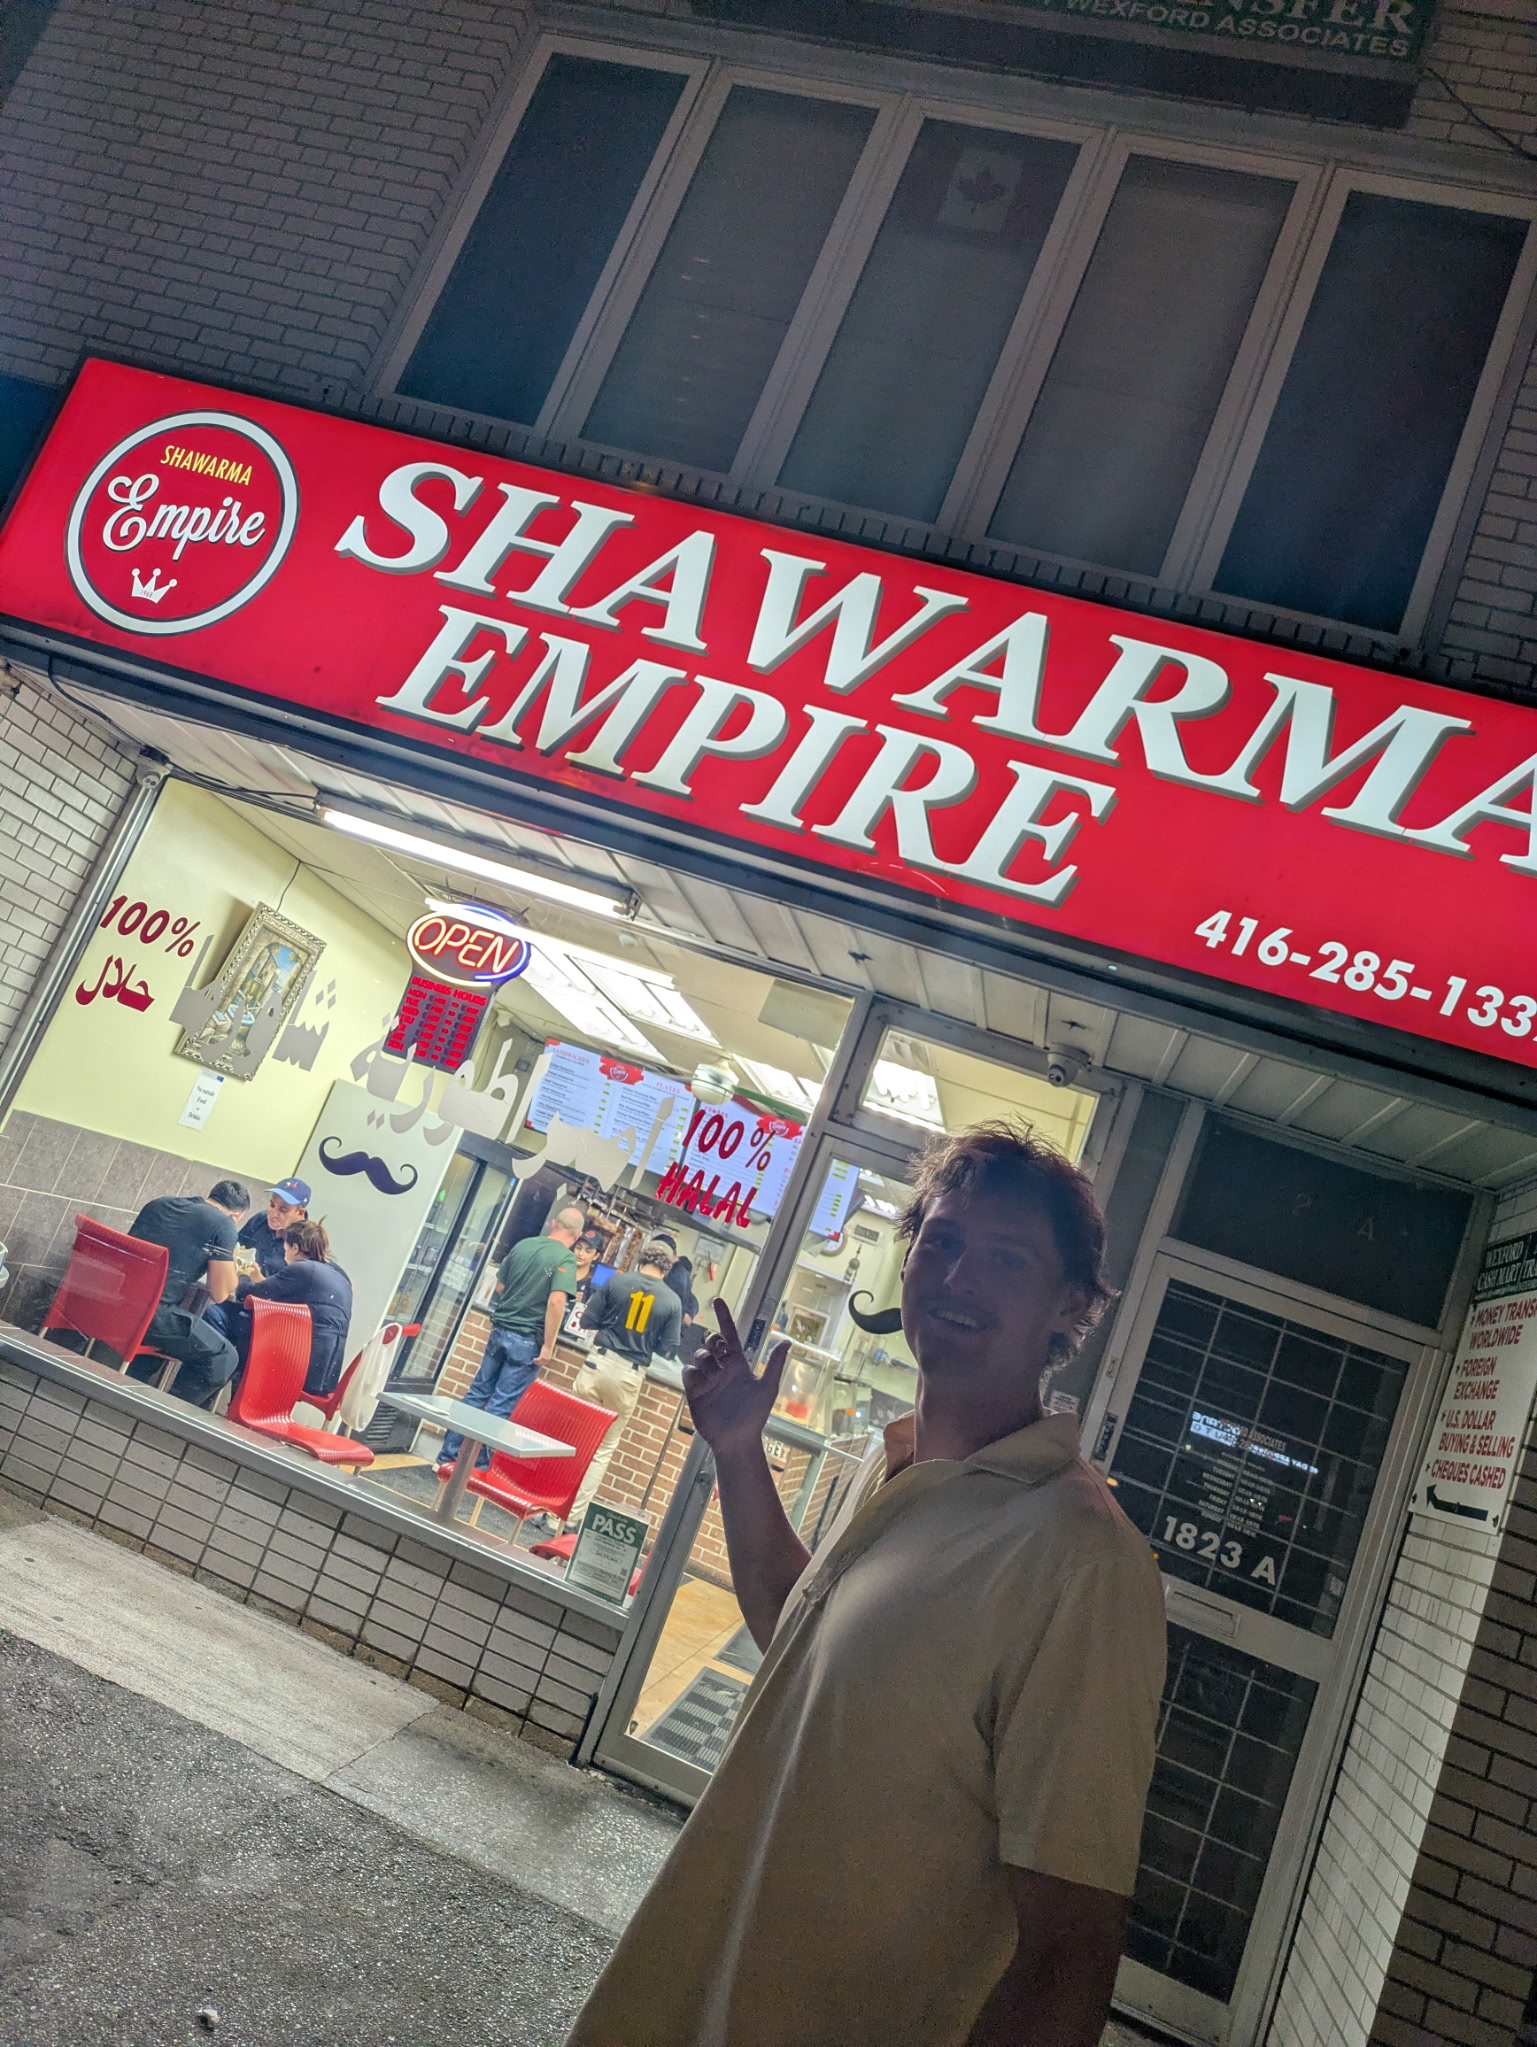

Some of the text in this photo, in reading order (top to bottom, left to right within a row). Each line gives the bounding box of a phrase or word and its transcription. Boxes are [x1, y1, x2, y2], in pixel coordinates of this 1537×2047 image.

[1213, 15, 1410, 56] ASSOCIATES
[159, 444, 254, 487] SHAWARMA
[102, 473, 267, 562] Empire
[334, 461, 1537, 873] SHAWARMA
[376, 604, 1117, 906] EMPIRE
[100, 894, 201, 958] 100%
[414, 917, 519, 974] OPEN
[75, 955, 155, 1012] حلال
[410, 976, 487, 1006] BUSINESS HOURS
[1194, 909, 1537, 1041] 416-285-133
[654, 1162, 759, 1228] HALAL
[625, 1291, 656, 1334] 11
[1475, 1304, 1504, 1328] MONEY
[1469, 1324, 1523, 1350] WORLDWIDE
[1460, 1356, 1498, 1378] FOREIGN
[1453, 1379, 1500, 1401] EXCHANGE
[1445, 1409, 1497, 1431] U.S. DOLLAR
[1438, 1432, 1515, 1459] BUYING & SELLING
[1430, 1458, 1507, 1490] CHEQUES CASHED
[591, 1512, 637, 1546] PASS
[1163, 1515, 1276, 1586] 1823 A
